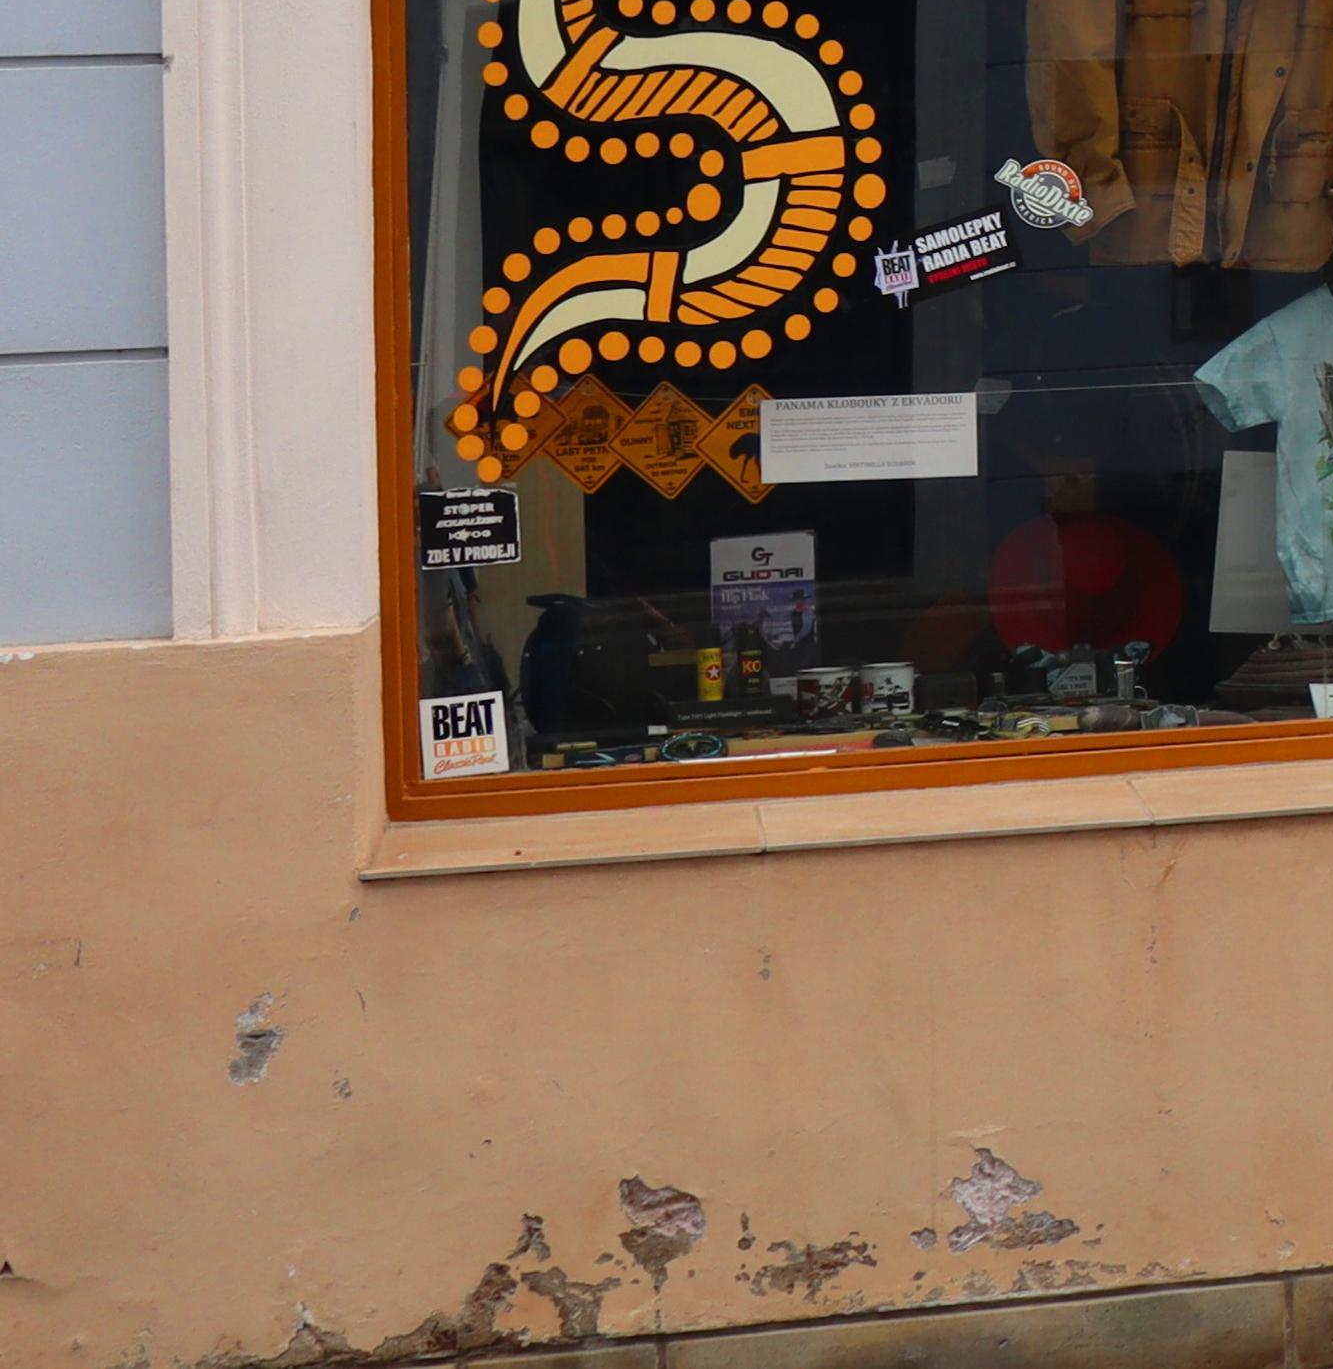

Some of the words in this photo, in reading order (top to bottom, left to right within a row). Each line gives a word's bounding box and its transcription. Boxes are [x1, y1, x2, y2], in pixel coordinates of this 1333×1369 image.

[914, 211, 1003, 254] SAMOLEPKY
[922, 243, 972, 273] RADIA
[969, 230, 1009, 258] BEAT
[882, 255, 911, 276] BEAT
[775, 399, 825, 411] PANAMA
[827, 397, 888, 409] KLOBOUKY
[891, 397, 899, 406] Z
[901, 394, 963, 406] EKVÁDORU
[426, 548, 450, 564] ZDE
[452, 546, 462, 563] V
[464, 542, 516, 561] PRODEJI
[431, 697, 496, 741] BEAT
[433, 736, 497, 759] RADIO
